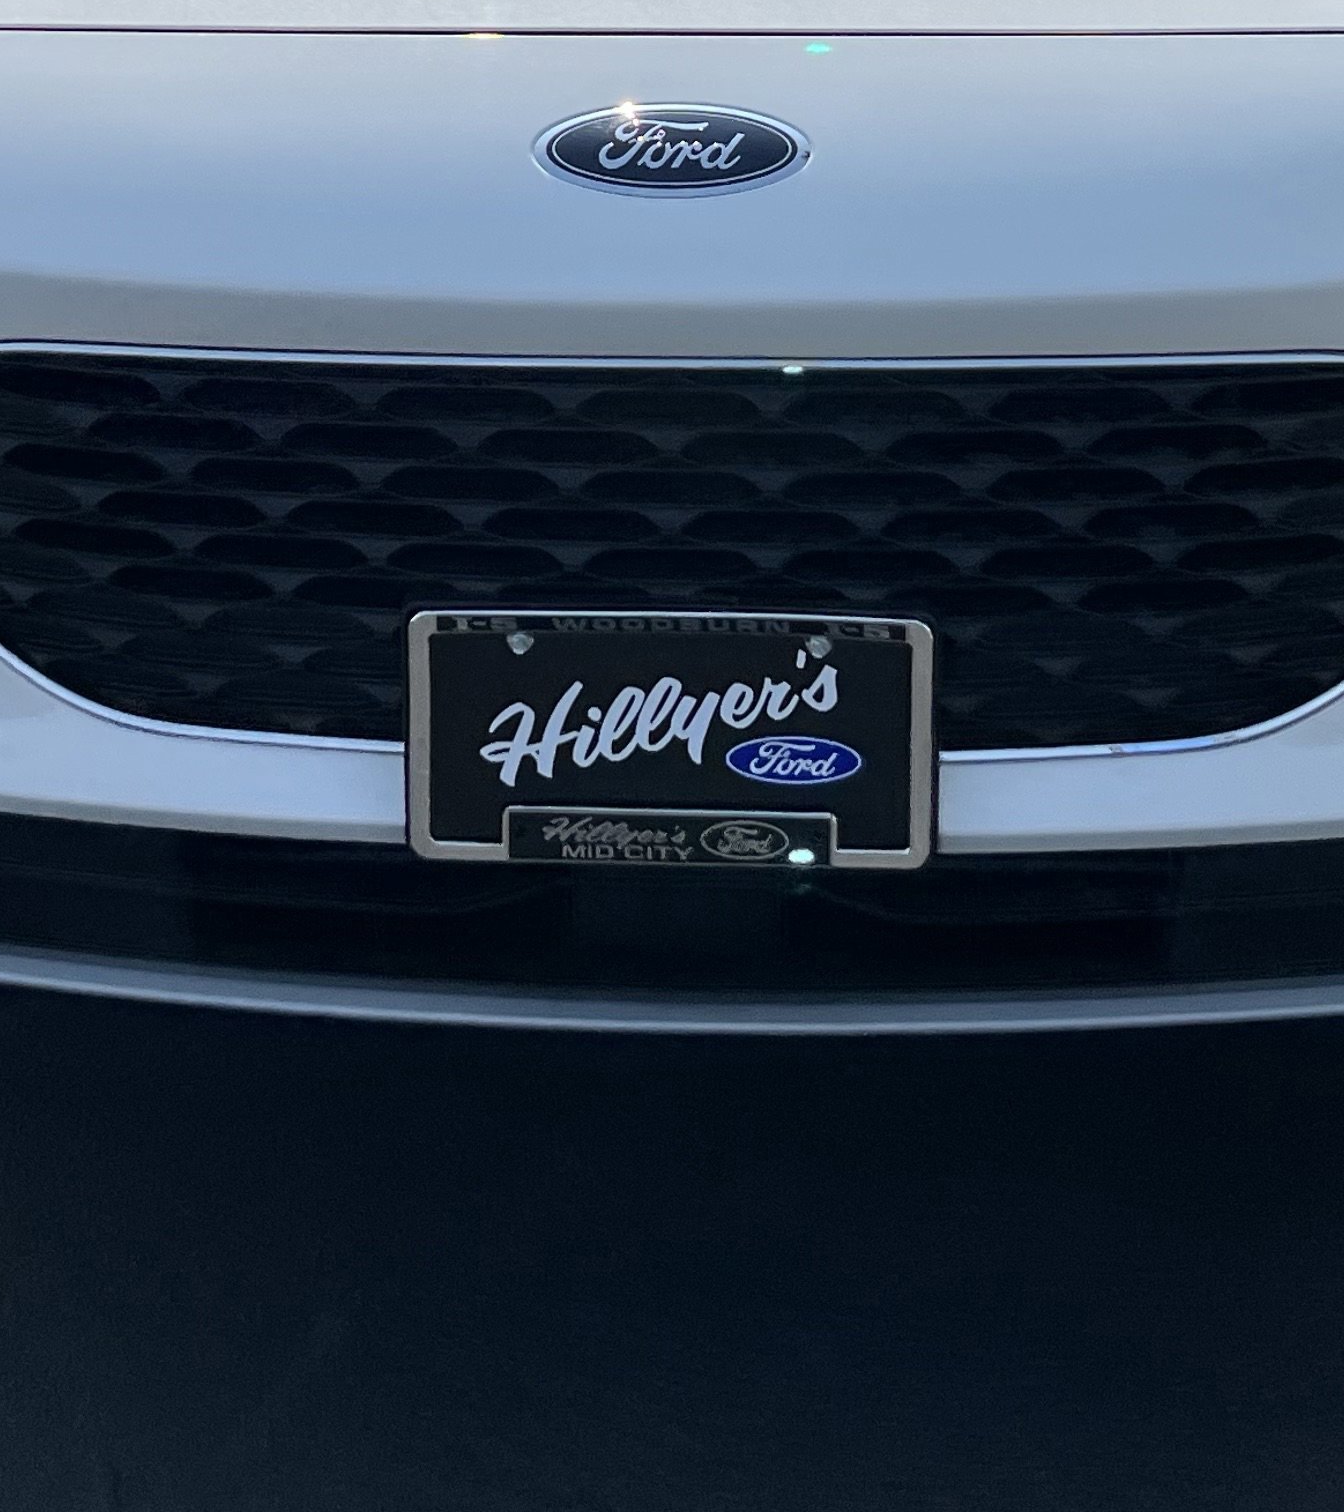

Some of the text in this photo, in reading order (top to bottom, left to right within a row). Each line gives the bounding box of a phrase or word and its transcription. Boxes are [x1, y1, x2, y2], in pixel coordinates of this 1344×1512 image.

[598, 119, 746, 171] Ford
[552, 617, 791, 634] WOODBURN
[479, 649, 838, 787] Hillyer's
[752, 739, 837, 778] Ford
[541, 816, 773, 854] Hillyer's Ford
[561, 844, 694, 860] MID CITY
